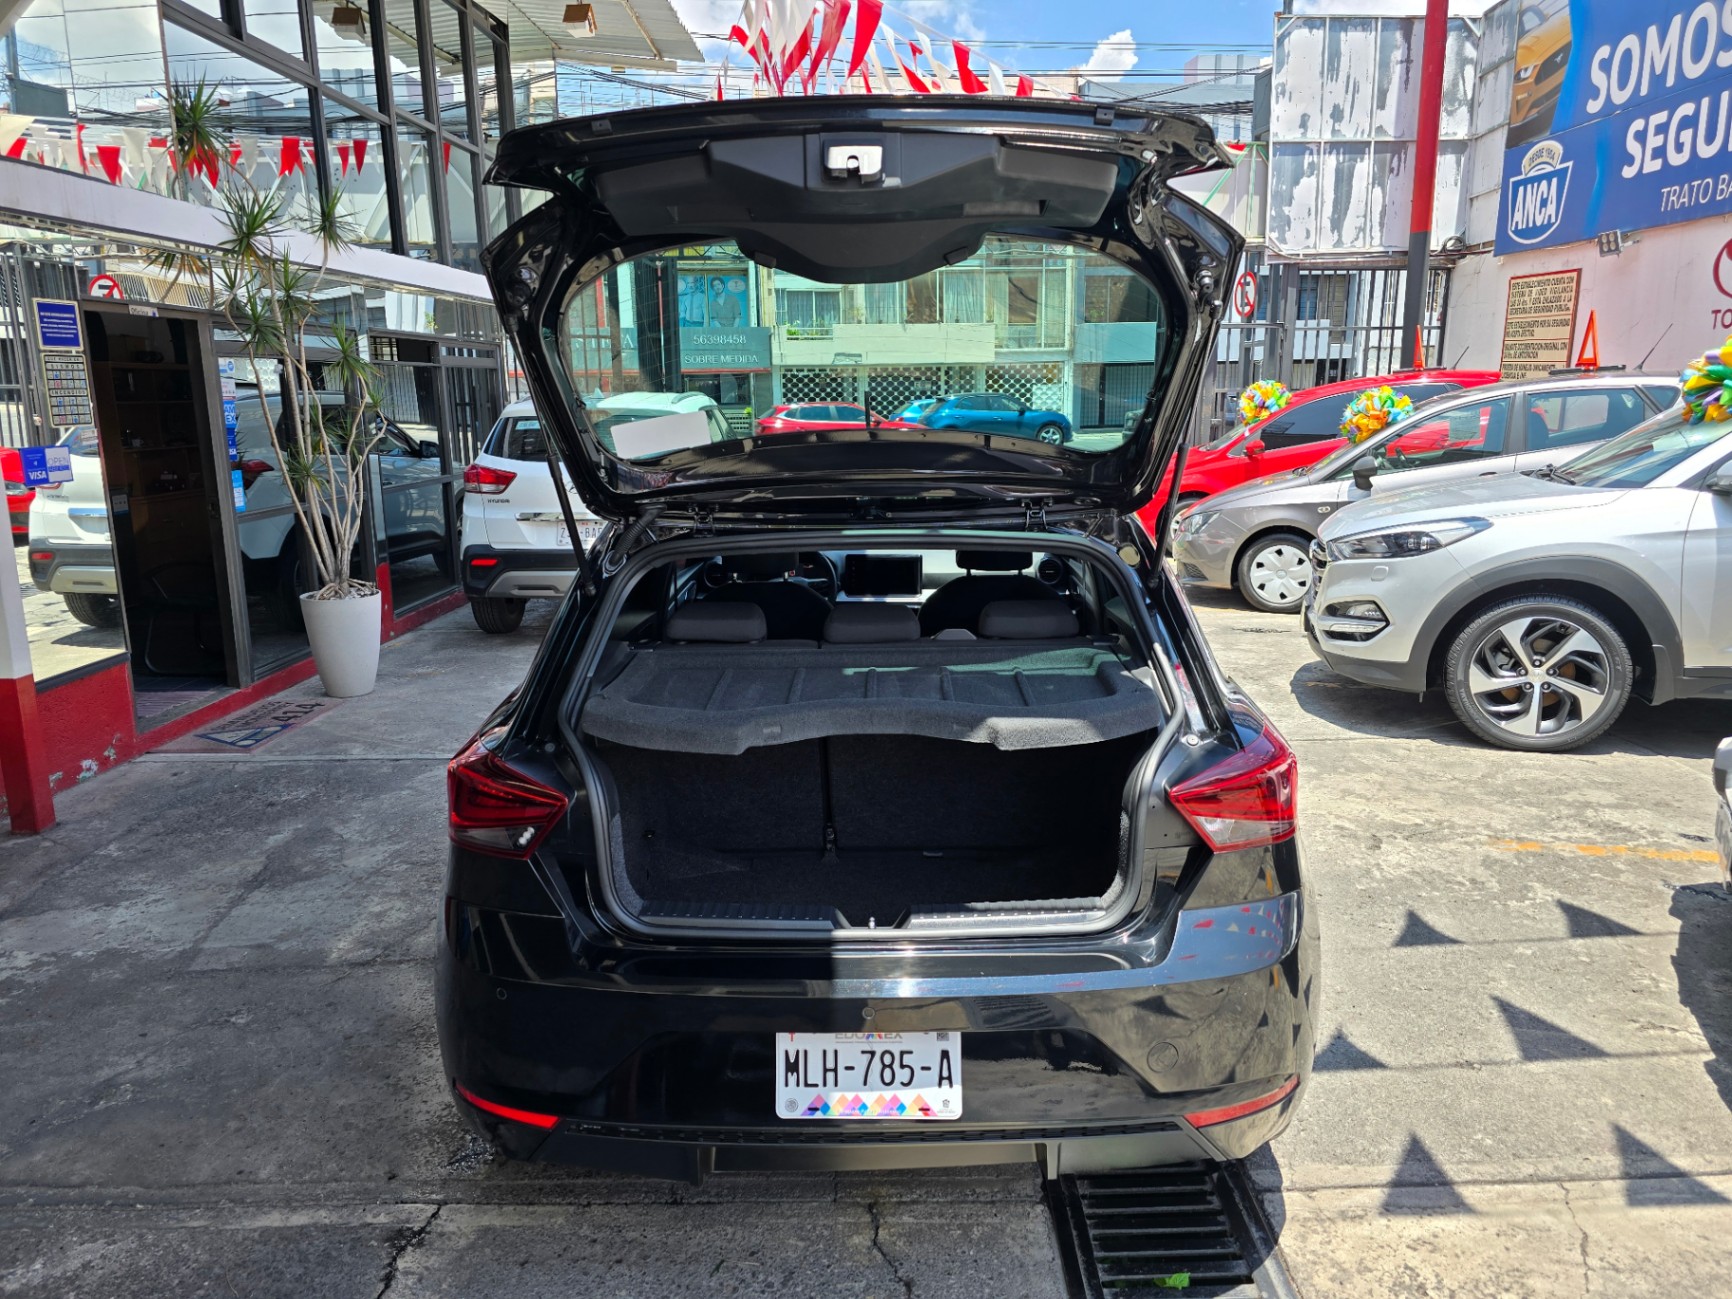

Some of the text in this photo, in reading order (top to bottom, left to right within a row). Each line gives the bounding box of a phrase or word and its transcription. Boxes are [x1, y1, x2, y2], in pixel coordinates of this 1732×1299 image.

[1621, 90, 1732, 179] SEGU
[1511, 176, 1558, 231] ANCA
[1661, 178, 1713, 212] TRATO
[693, 334, 747, 345] 56398458
[684, 354, 759, 364] SOBRE MEDIDA
[28, 470, 47, 480] VISA
[271, 702, 325, 722] 414
[784, 1048, 954, 1089] MLH-785-A
